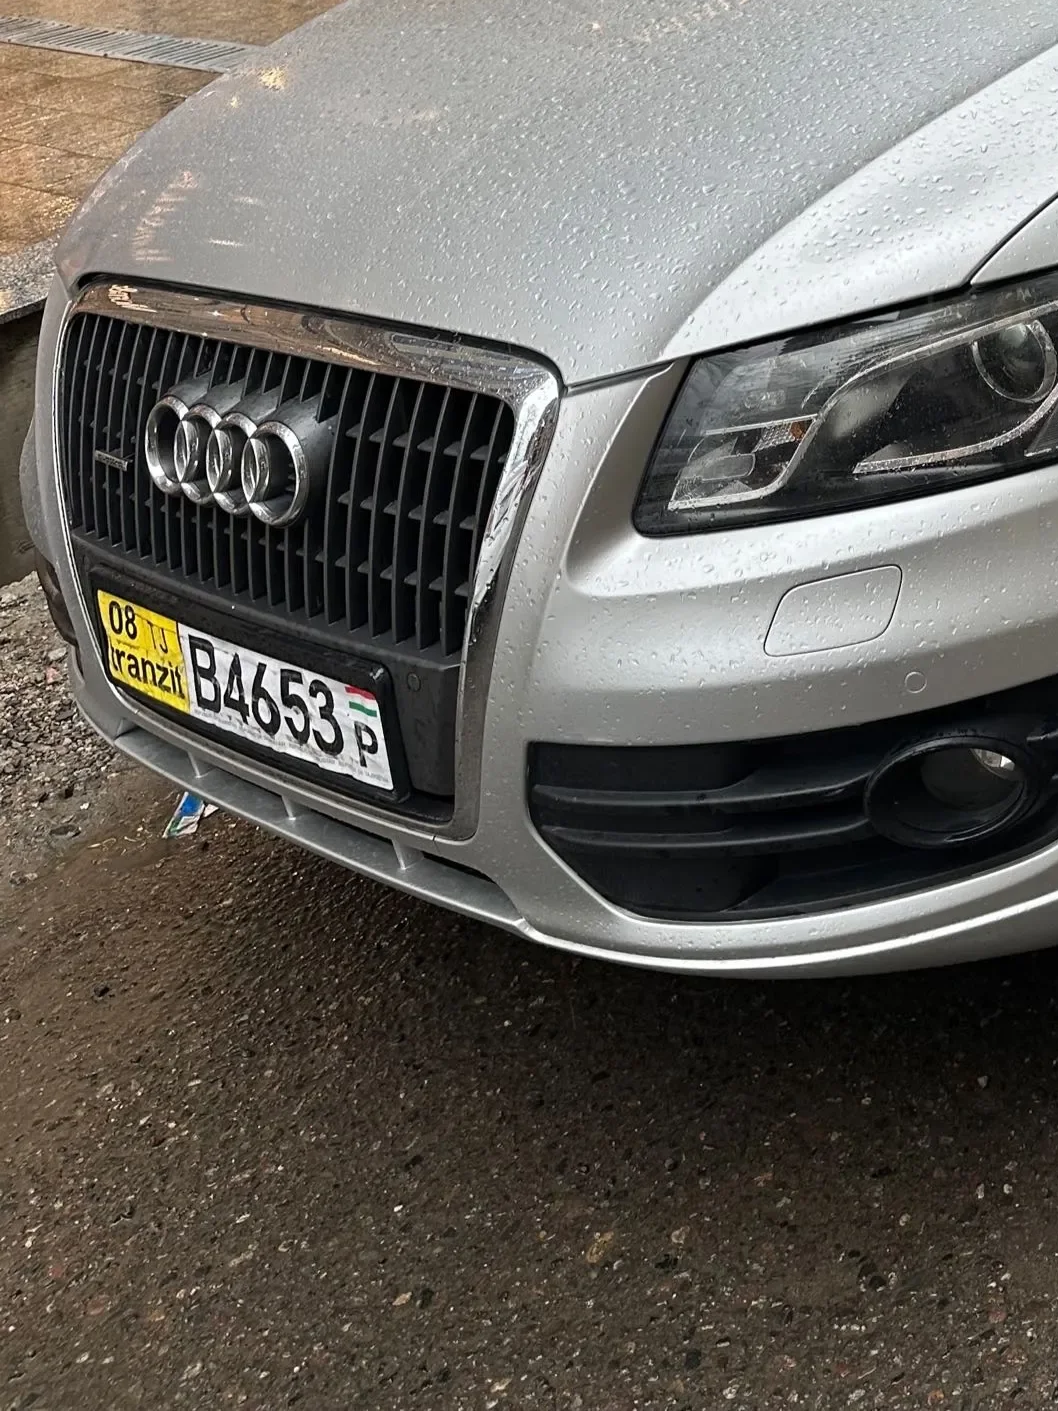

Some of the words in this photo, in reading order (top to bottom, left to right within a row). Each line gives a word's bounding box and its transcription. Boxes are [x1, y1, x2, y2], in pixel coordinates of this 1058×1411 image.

[108, 600, 138, 640] 08
[109, 640, 185, 699] tranzit
[188, 634, 344, 757] B4653
[353, 720, 379, 767] P
